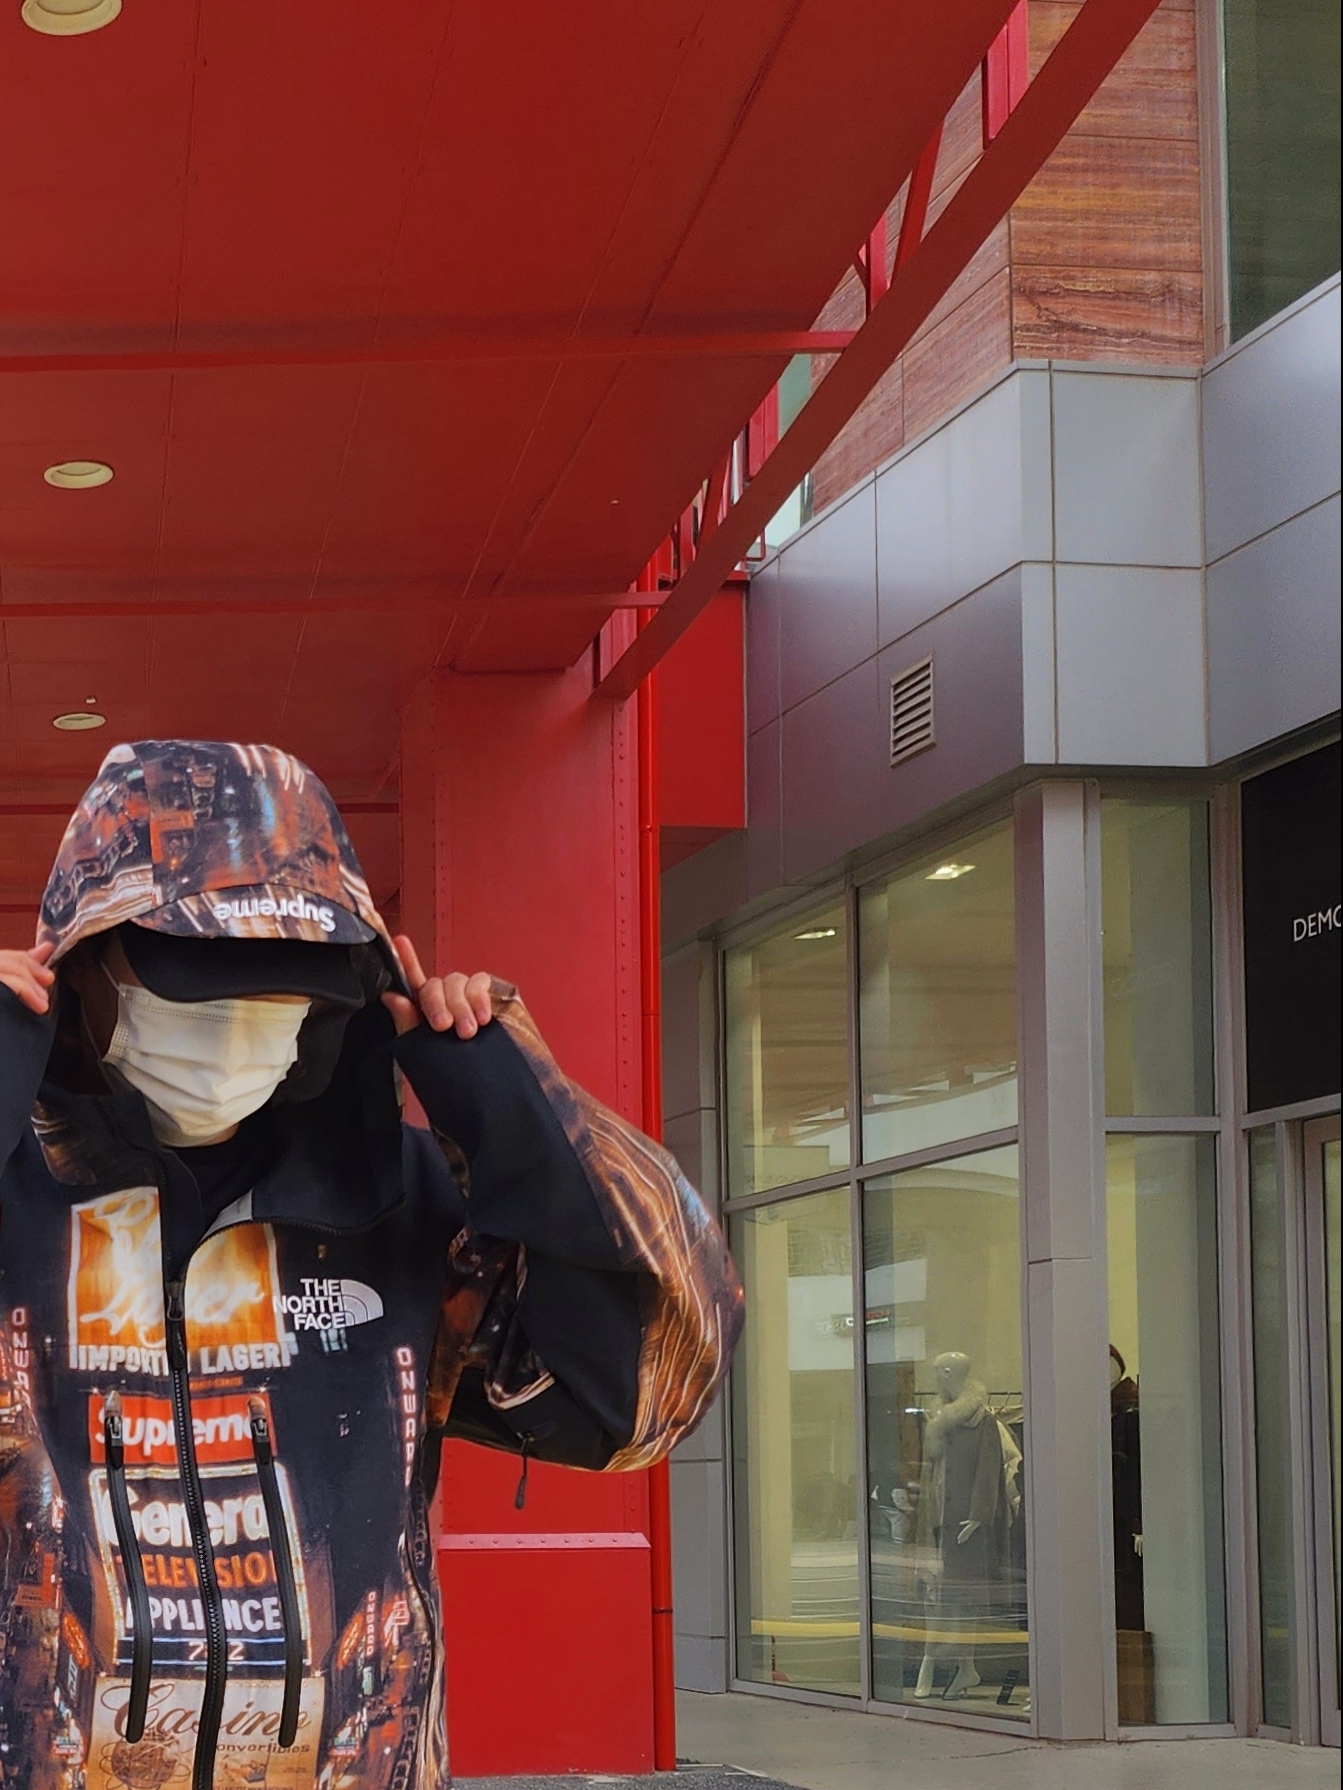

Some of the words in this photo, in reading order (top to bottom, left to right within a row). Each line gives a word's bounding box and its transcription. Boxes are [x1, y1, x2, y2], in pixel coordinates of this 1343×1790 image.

[212, 892, 337, 933] Supreme
[300, 1277, 341, 1297] THE
[272, 1294, 344, 1314] NORTH
[293, 1311, 346, 1331] FACE
[200, 1341, 281, 1376] LAGER
[187, 1640, 245, 1661] 72
